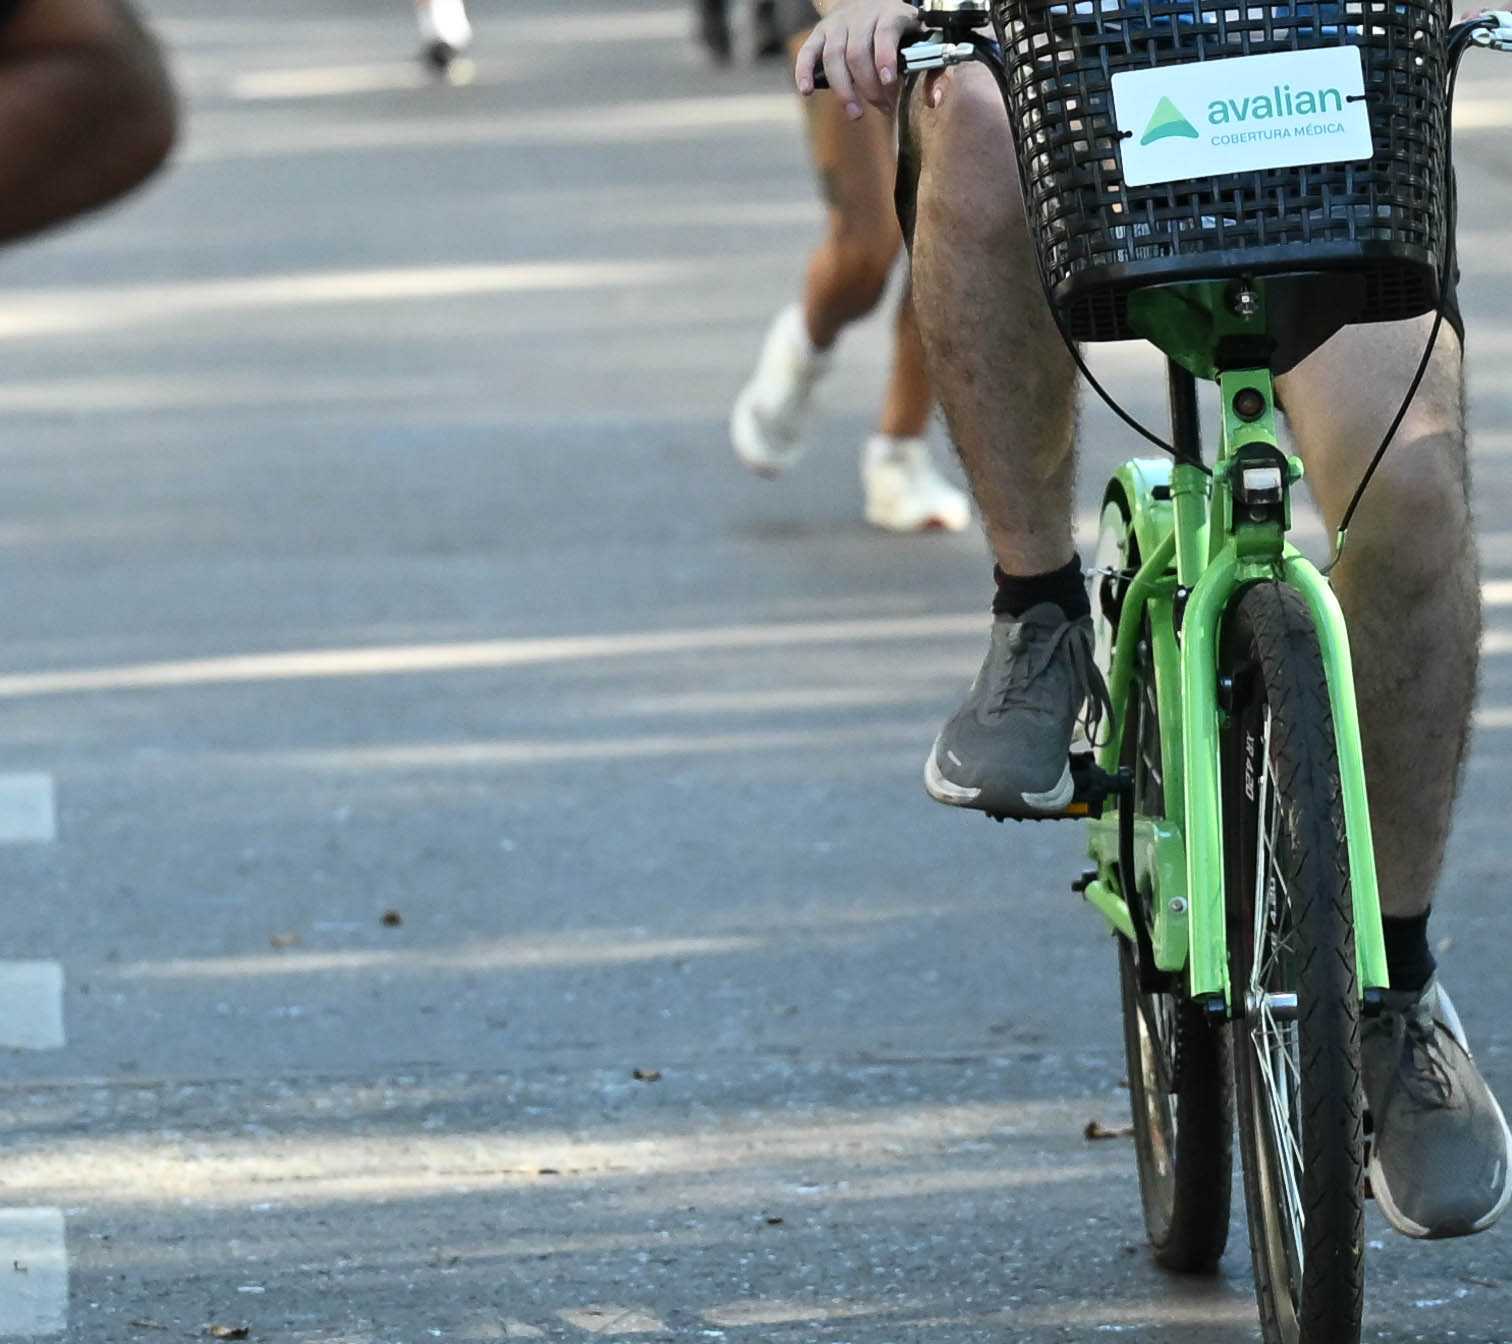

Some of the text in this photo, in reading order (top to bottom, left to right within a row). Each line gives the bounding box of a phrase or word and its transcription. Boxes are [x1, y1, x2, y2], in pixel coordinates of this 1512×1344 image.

[1207, 84, 1343, 125] avalian
[1210, 123, 1345, 146] COBERTURA MÉDICA
